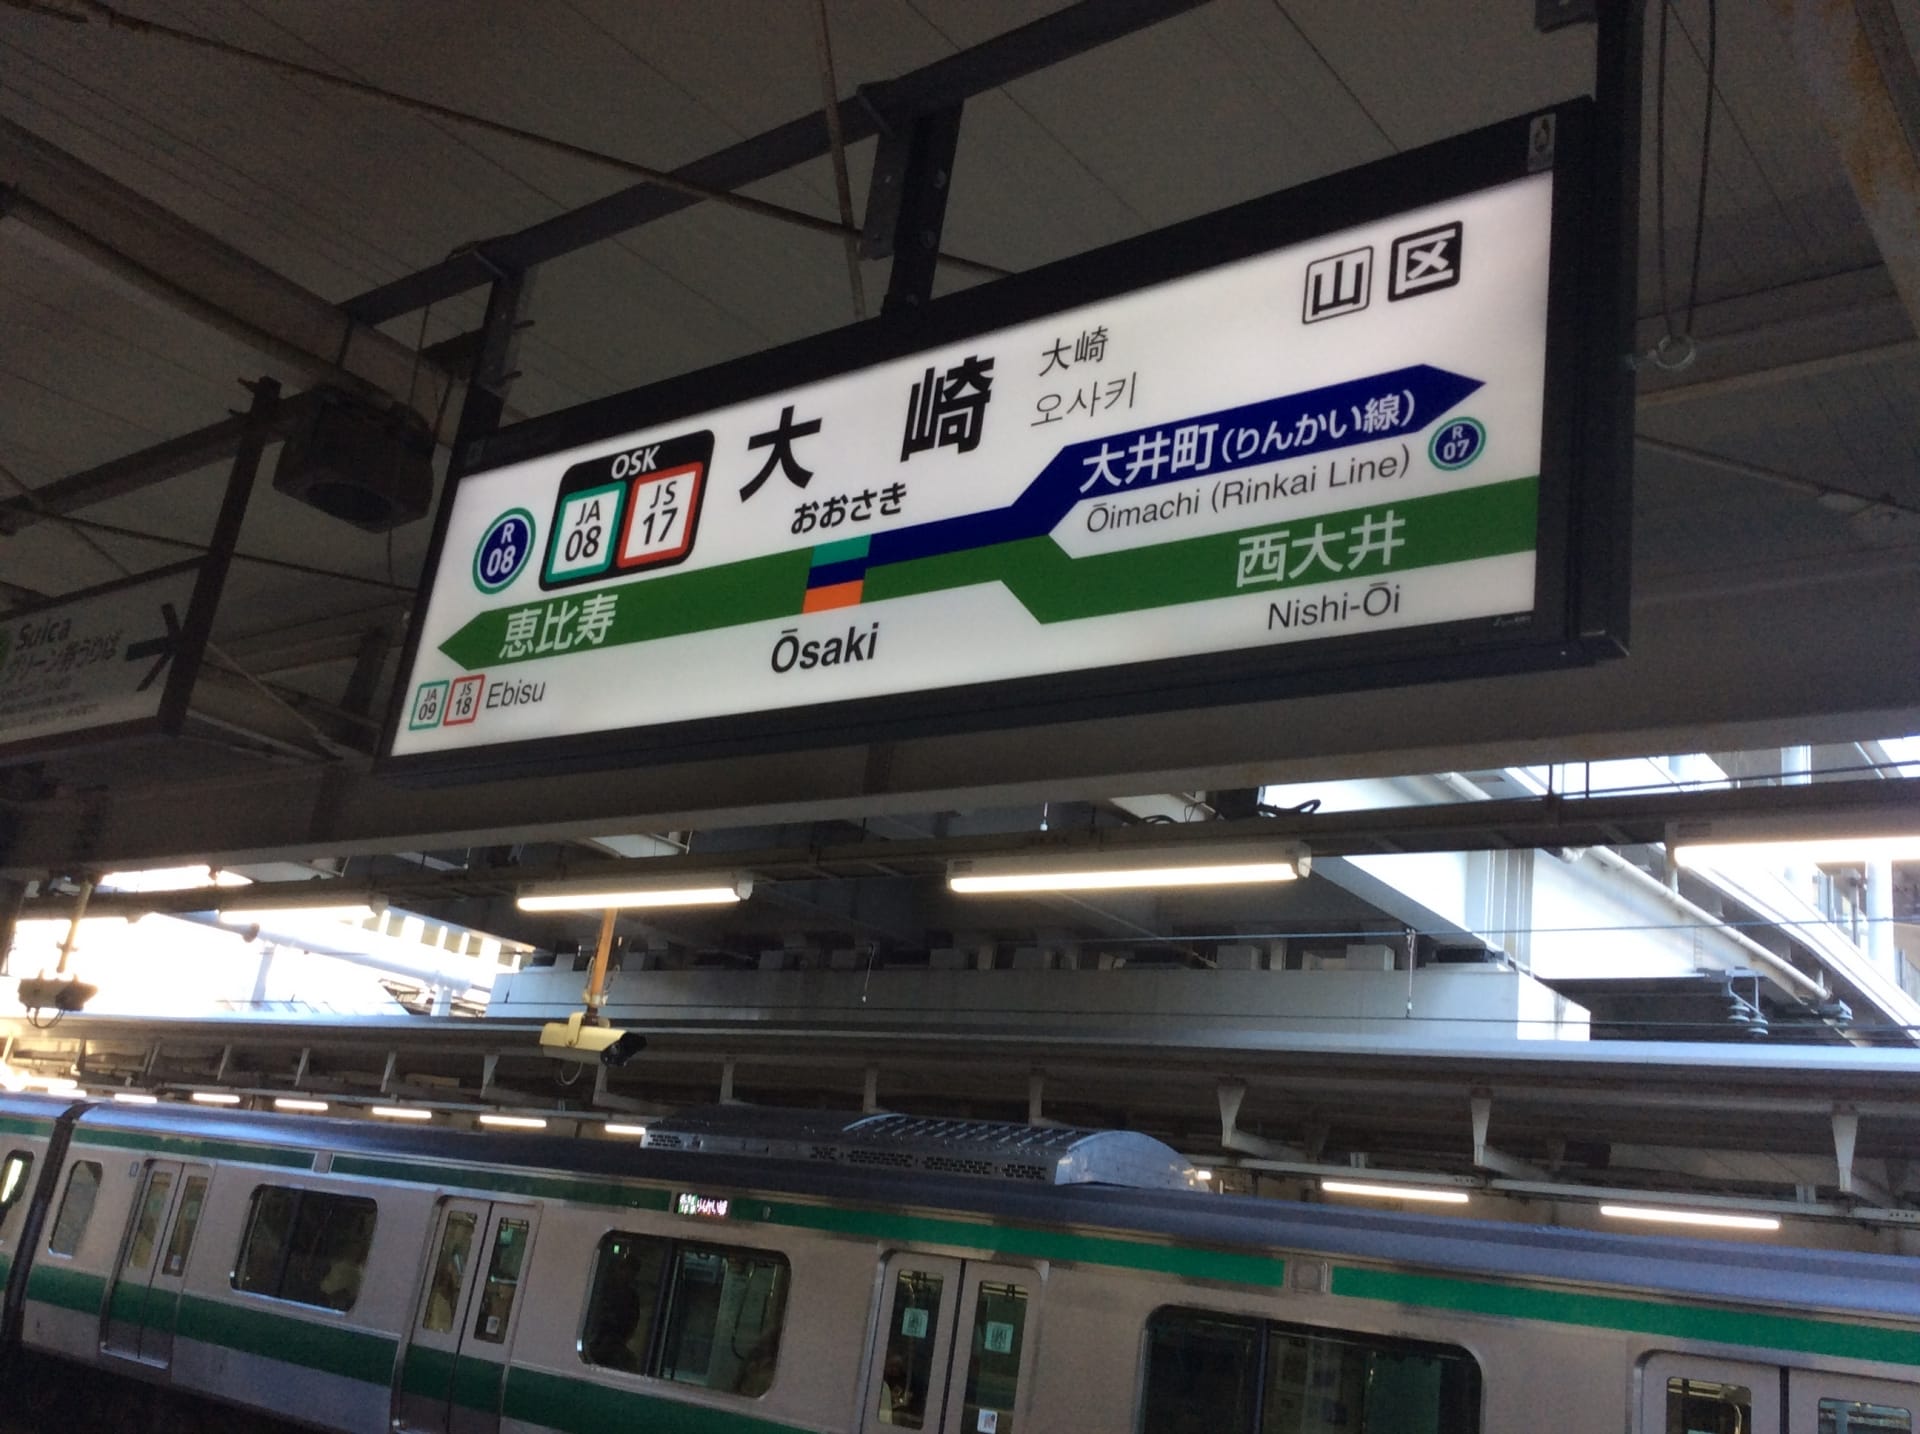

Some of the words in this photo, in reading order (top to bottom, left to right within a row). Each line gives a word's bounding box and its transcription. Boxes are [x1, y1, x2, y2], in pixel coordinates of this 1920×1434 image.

[1396, 228, 1456, 297] 区
[1312, 259, 1364, 316] 山
[1038, 324, 1109, 377] 大崎
[1030, 371, 1138, 428] 오사키
[1443, 438, 1470, 461] 07
[1452, 425, 1464, 440] R
[610, 445, 661, 480] OSK
[1210, 465, 1317, 516] (Rinkai
[1328, 442, 1411, 488] Line)
[649, 480, 678, 509] JS
[790, 481, 908, 535] おおさき
[575, 499, 601, 527] JA
[642, 507, 679, 546] 17
[500, 522, 515, 544] R
[564, 525, 602, 562] 08
[1235, 509, 1407, 588] 西大井
[486, 544, 517, 577] 08
[498, 593, 619, 660] 恵比寿
[770, 621, 880, 675] Ōsaki
[425, 689, 437, 701] JA
[455, 698, 472, 716] 18
[460, 683, 472, 697] JS
[486, 679, 546, 709] Ebisu
[418, 702, 437, 720] 09
